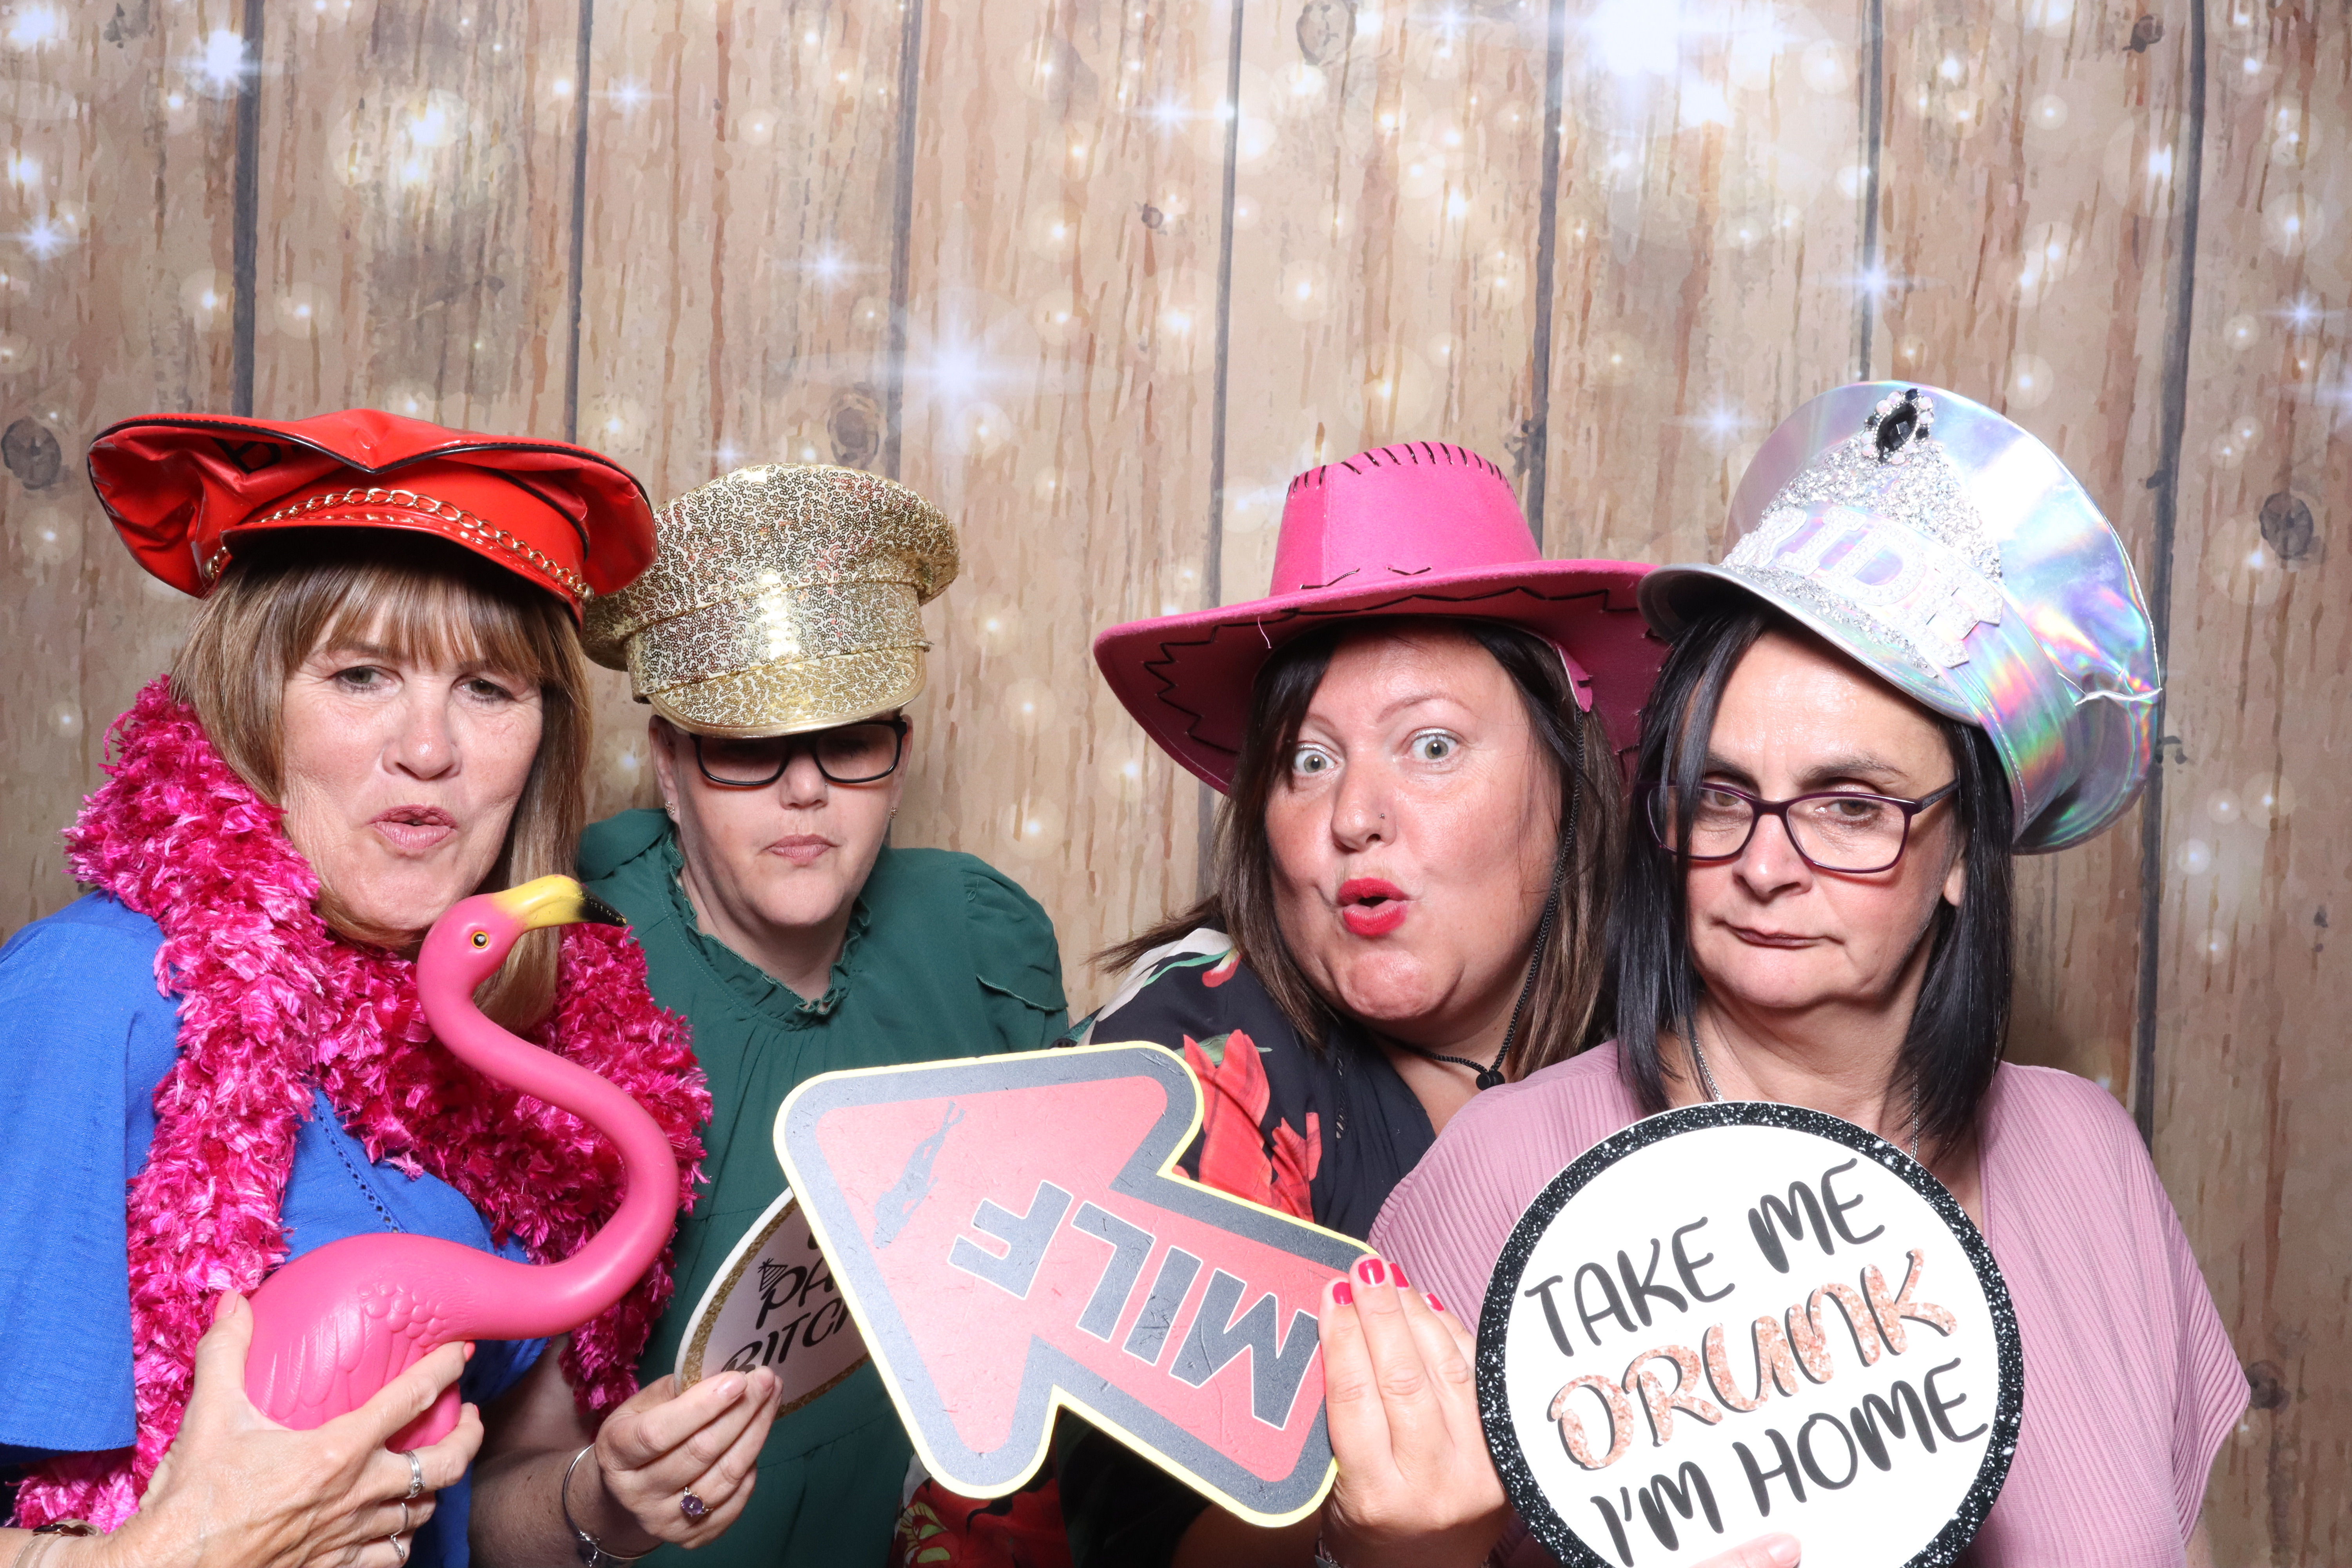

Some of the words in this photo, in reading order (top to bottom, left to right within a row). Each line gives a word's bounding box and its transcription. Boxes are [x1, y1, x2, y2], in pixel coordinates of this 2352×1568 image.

[1719, 507, 2004, 668] RIDE
[756, 1257, 835, 1330] PA
[947, 1181, 1321, 1430] MILF
[1524, 1216, 1736, 1357] TAKE
[1748, 1158, 1886, 1274] ME
[1546, 1249, 1957, 1471] DRUNK
[1590, 1461, 1724, 1568] I'M
[1731, 1357, 1989, 1517] HOME
